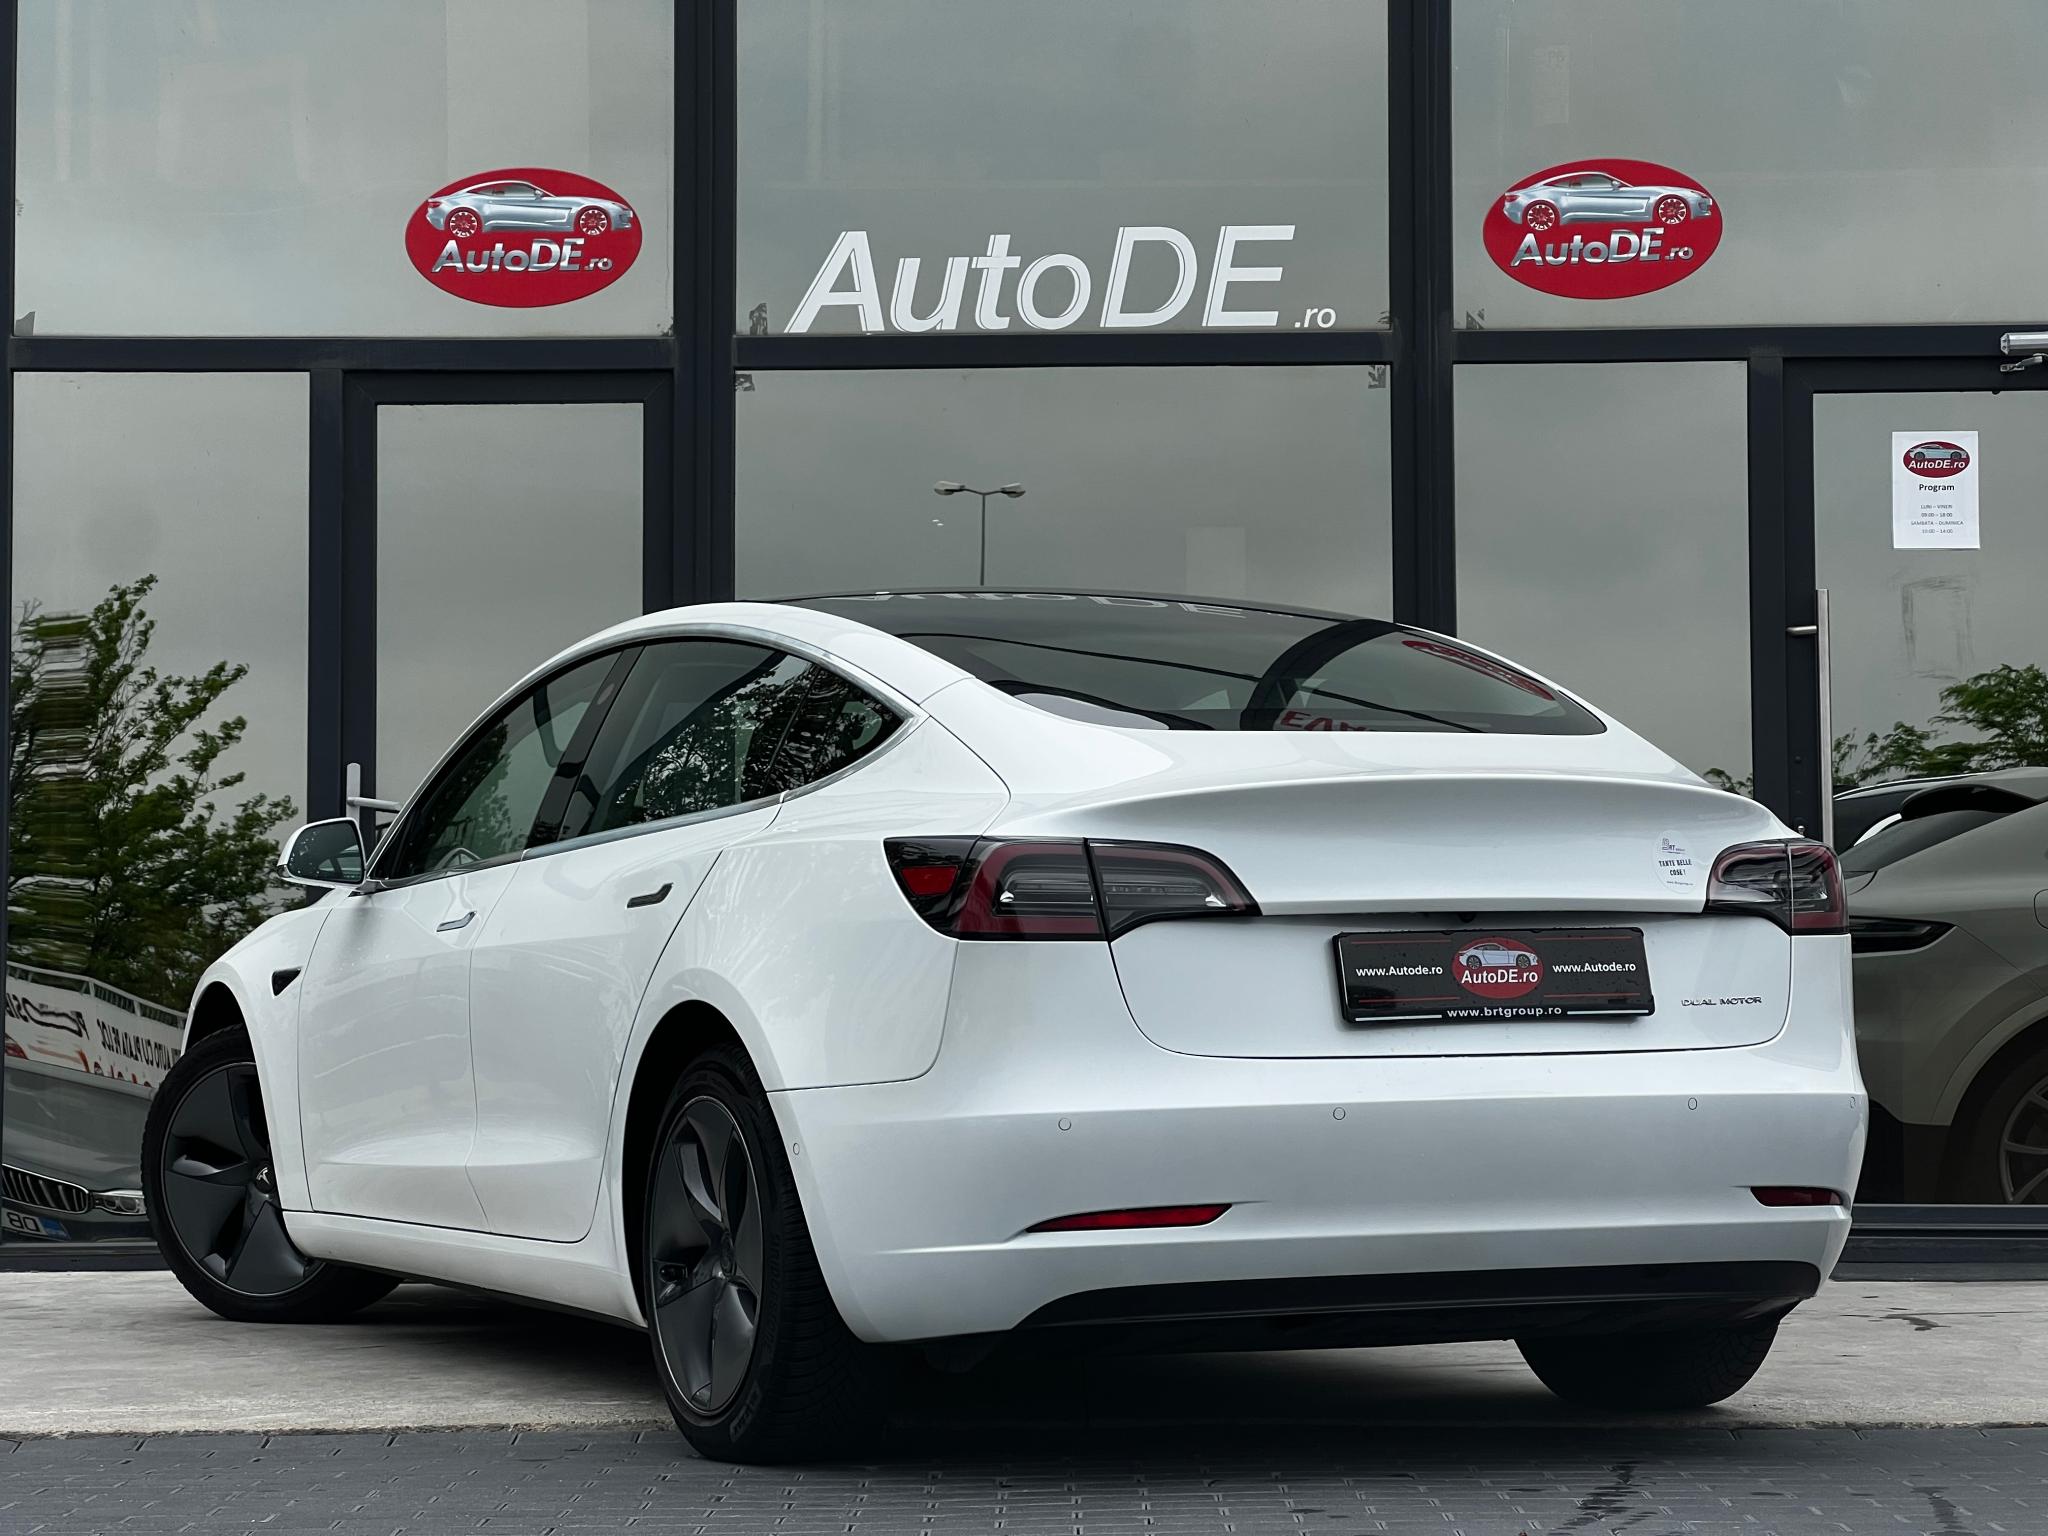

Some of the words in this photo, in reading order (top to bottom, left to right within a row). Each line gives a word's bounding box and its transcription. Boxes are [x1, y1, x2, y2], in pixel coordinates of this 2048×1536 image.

[1908, 460, 1966, 469] AutoDE.ro
[1919, 484, 1955, 492] Program
[1356, 964, 1443, 977] www.Autode.ro
[1552, 962, 1637, 974] www.Autode.ro
[1461, 969, 1539, 984] AutoDE.ro
[1720, 997, 1762, 1005] MOTOR
[1447, 1006, 1562, 1018] www.brtgroup.ro
